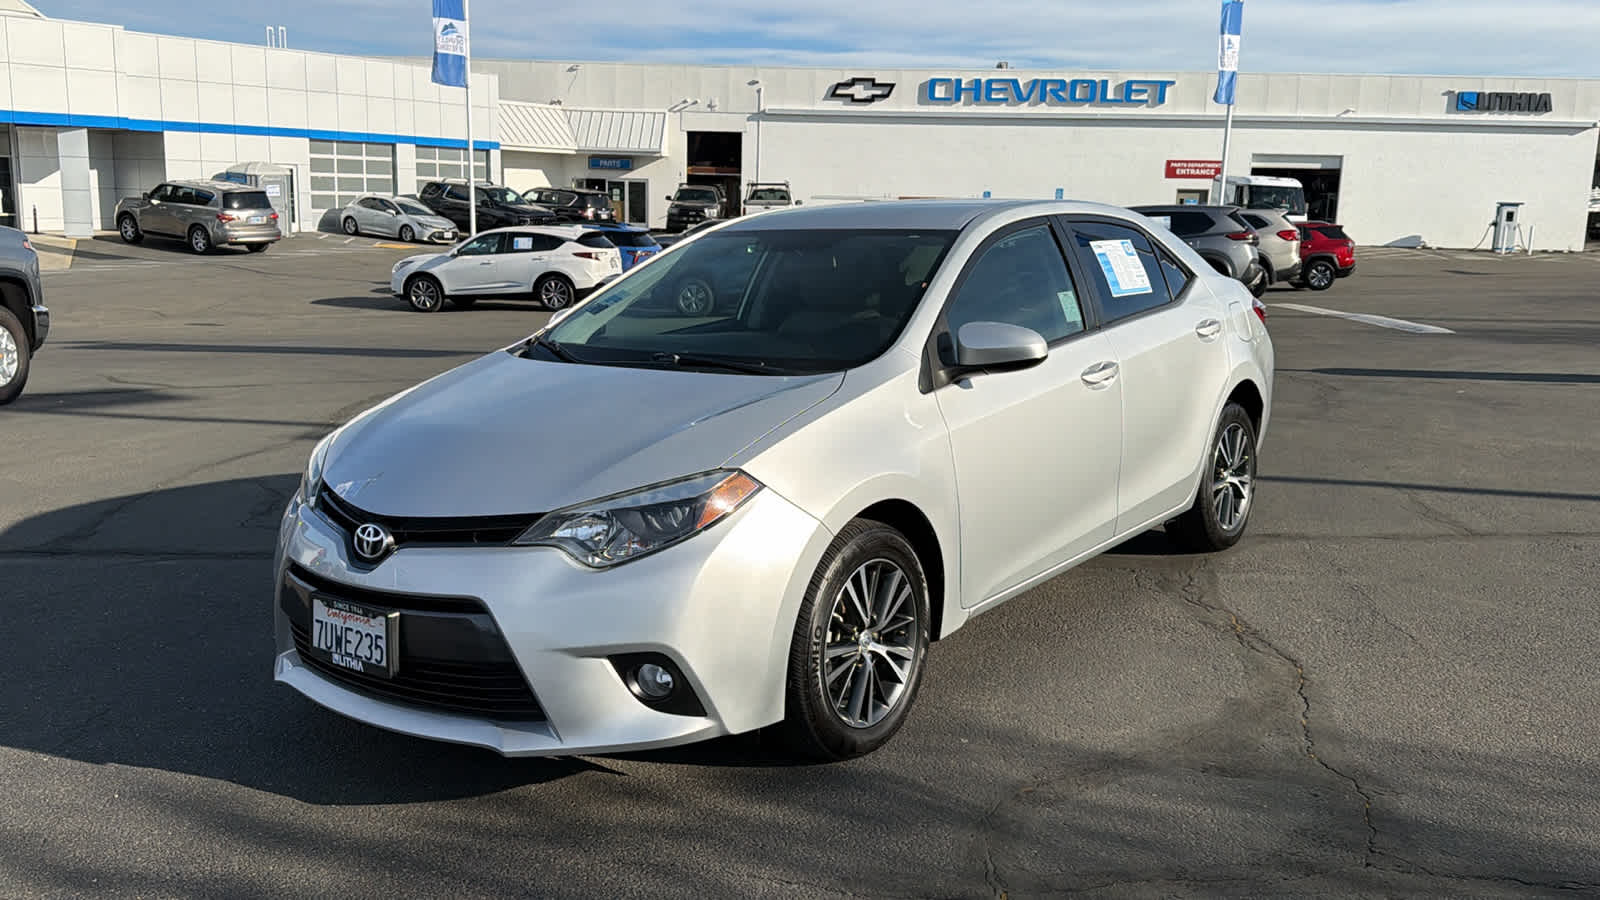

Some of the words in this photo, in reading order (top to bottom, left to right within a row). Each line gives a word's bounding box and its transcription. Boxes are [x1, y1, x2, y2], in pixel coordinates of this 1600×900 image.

[928, 78, 1176, 104] CHEVROLET
[1477, 91, 1553, 112] LITHIA
[600, 160, 621, 168] PARTS
[315, 619, 384, 664] 7UWE235
[339, 655, 364, 673] LITHIA
